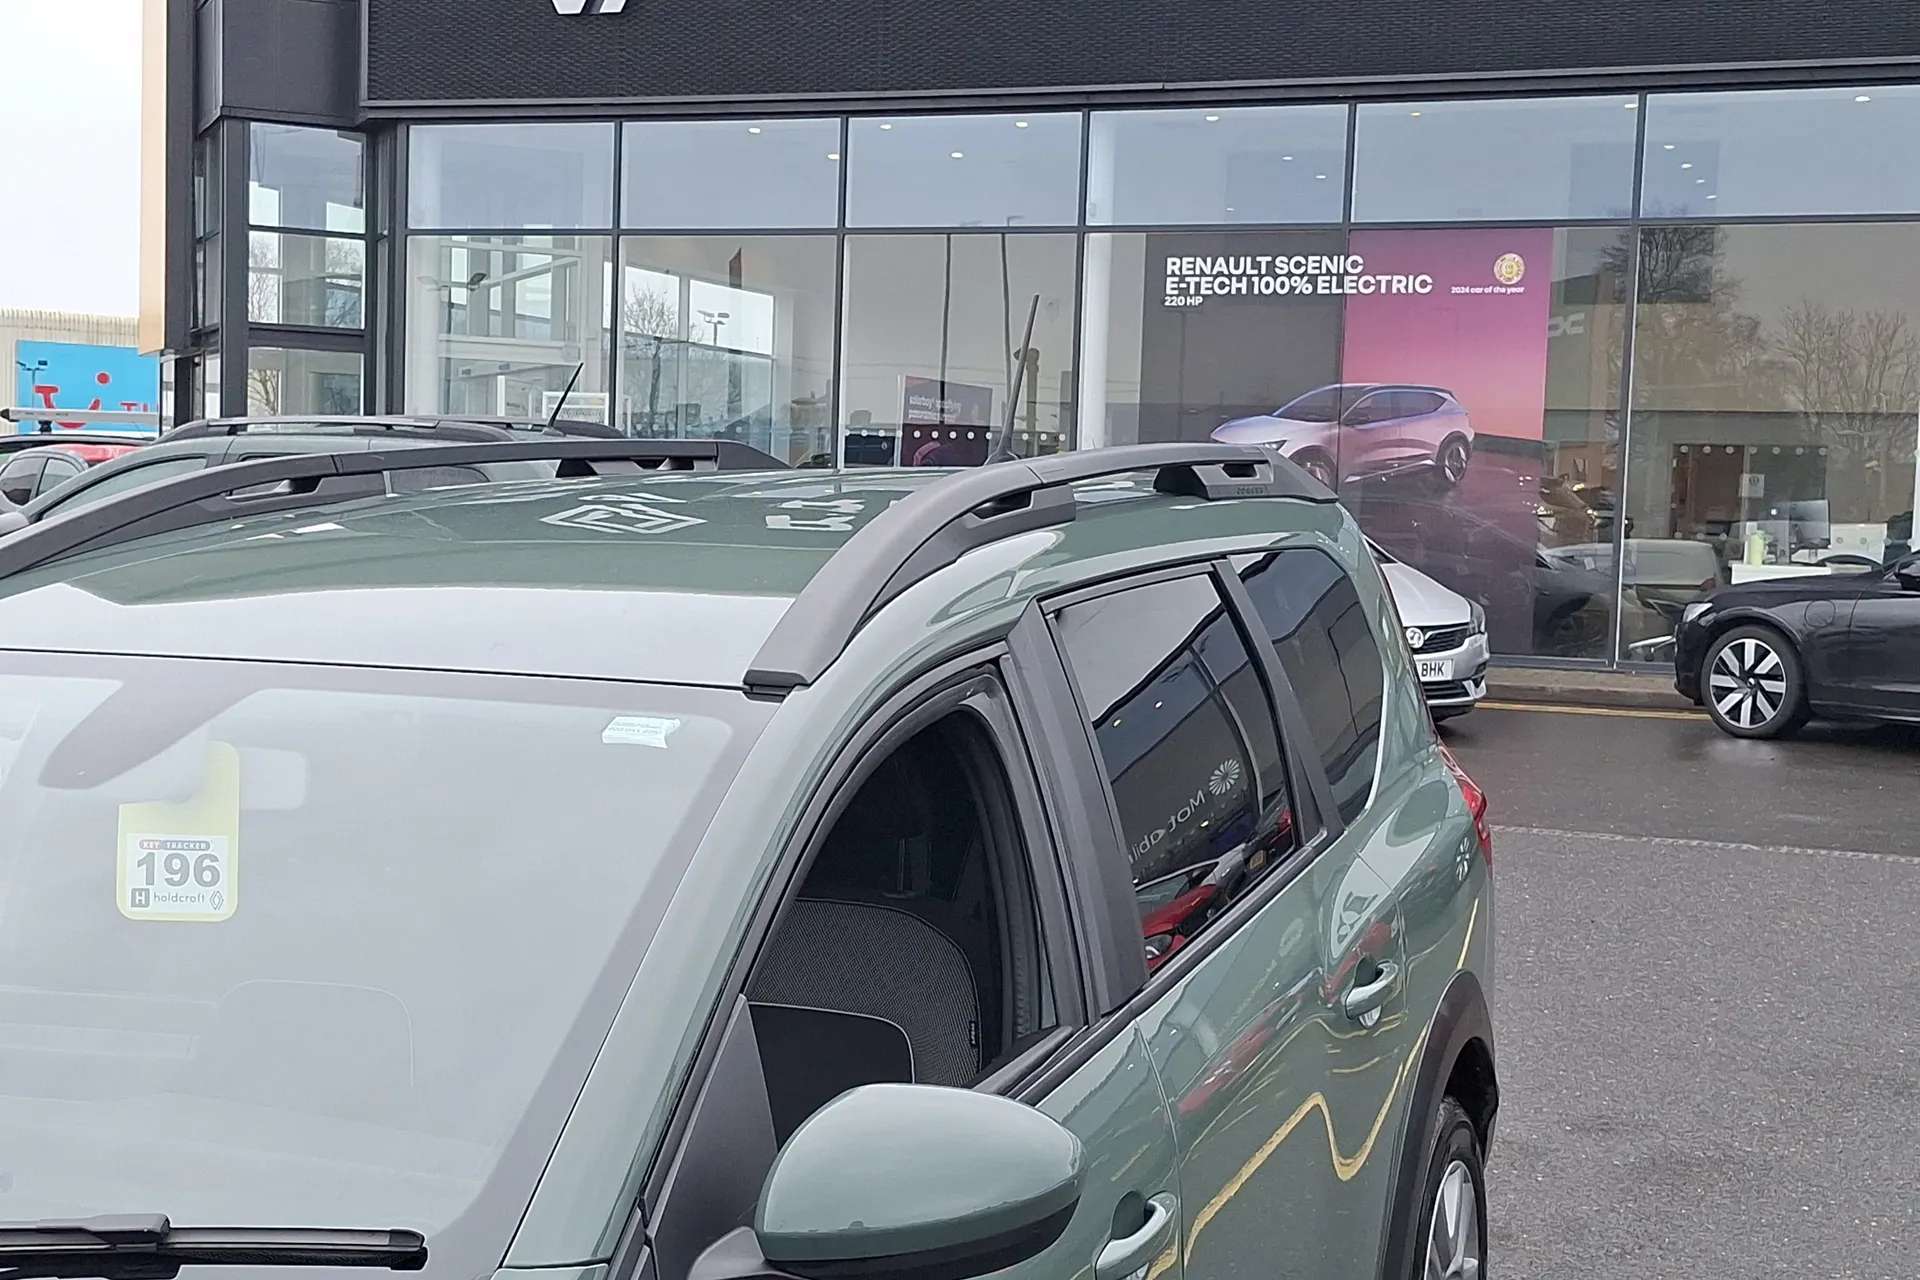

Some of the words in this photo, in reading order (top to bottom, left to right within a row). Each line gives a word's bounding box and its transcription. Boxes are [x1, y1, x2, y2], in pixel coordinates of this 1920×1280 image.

[1166, 255, 1272, 275] RENAULT
[1274, 254, 1364, 274] SCENIC
[1166, 276, 1247, 295] E-TECH
[1251, 276, 1313, 295] 100%
[1317, 274, 1433, 295] ELECTRIC
[1507, 286, 1525, 295] year
[1164, 296, 1186, 307] 220
[1186, 296, 1203, 306] HP
[137, 851, 221, 888] 196
[153, 891, 205, 903] holdcroft
